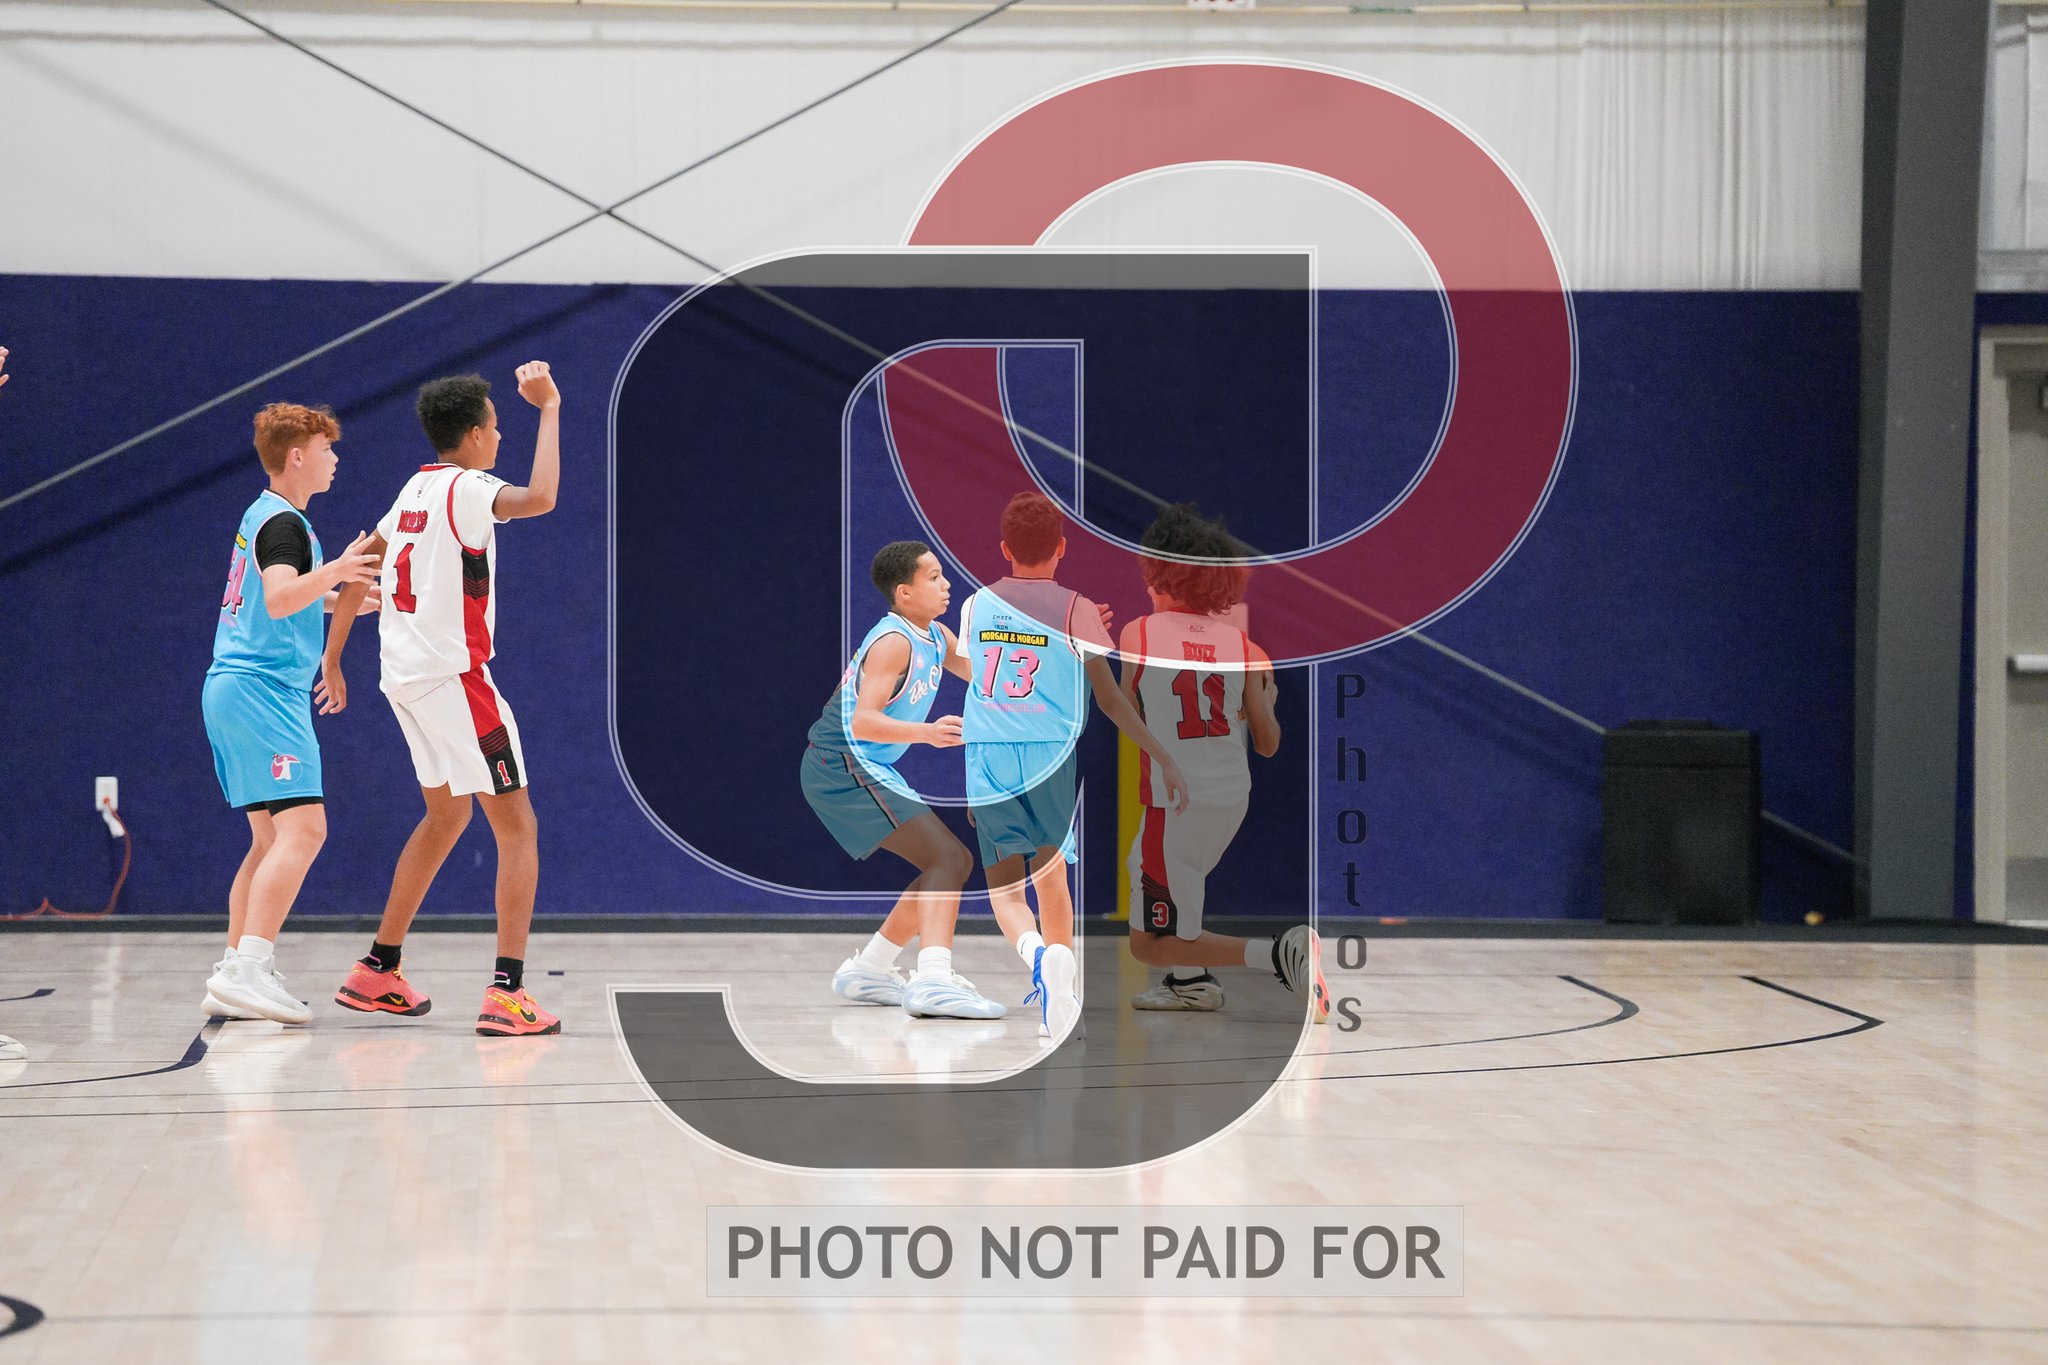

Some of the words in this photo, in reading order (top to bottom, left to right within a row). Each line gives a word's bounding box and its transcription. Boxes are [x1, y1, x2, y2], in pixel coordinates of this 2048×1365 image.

[391, 542, 417, 614] 1
[981, 631, 1009, 643] MORGAN
[1010, 633, 1016, 642] &
[1016, 634, 1046, 646] MORGAN
[981, 646, 1041, 699] 13
[1171, 669, 1231, 740] 11
[497, 760, 512, 786] 1
[1152, 902, 1169, 928] 3
